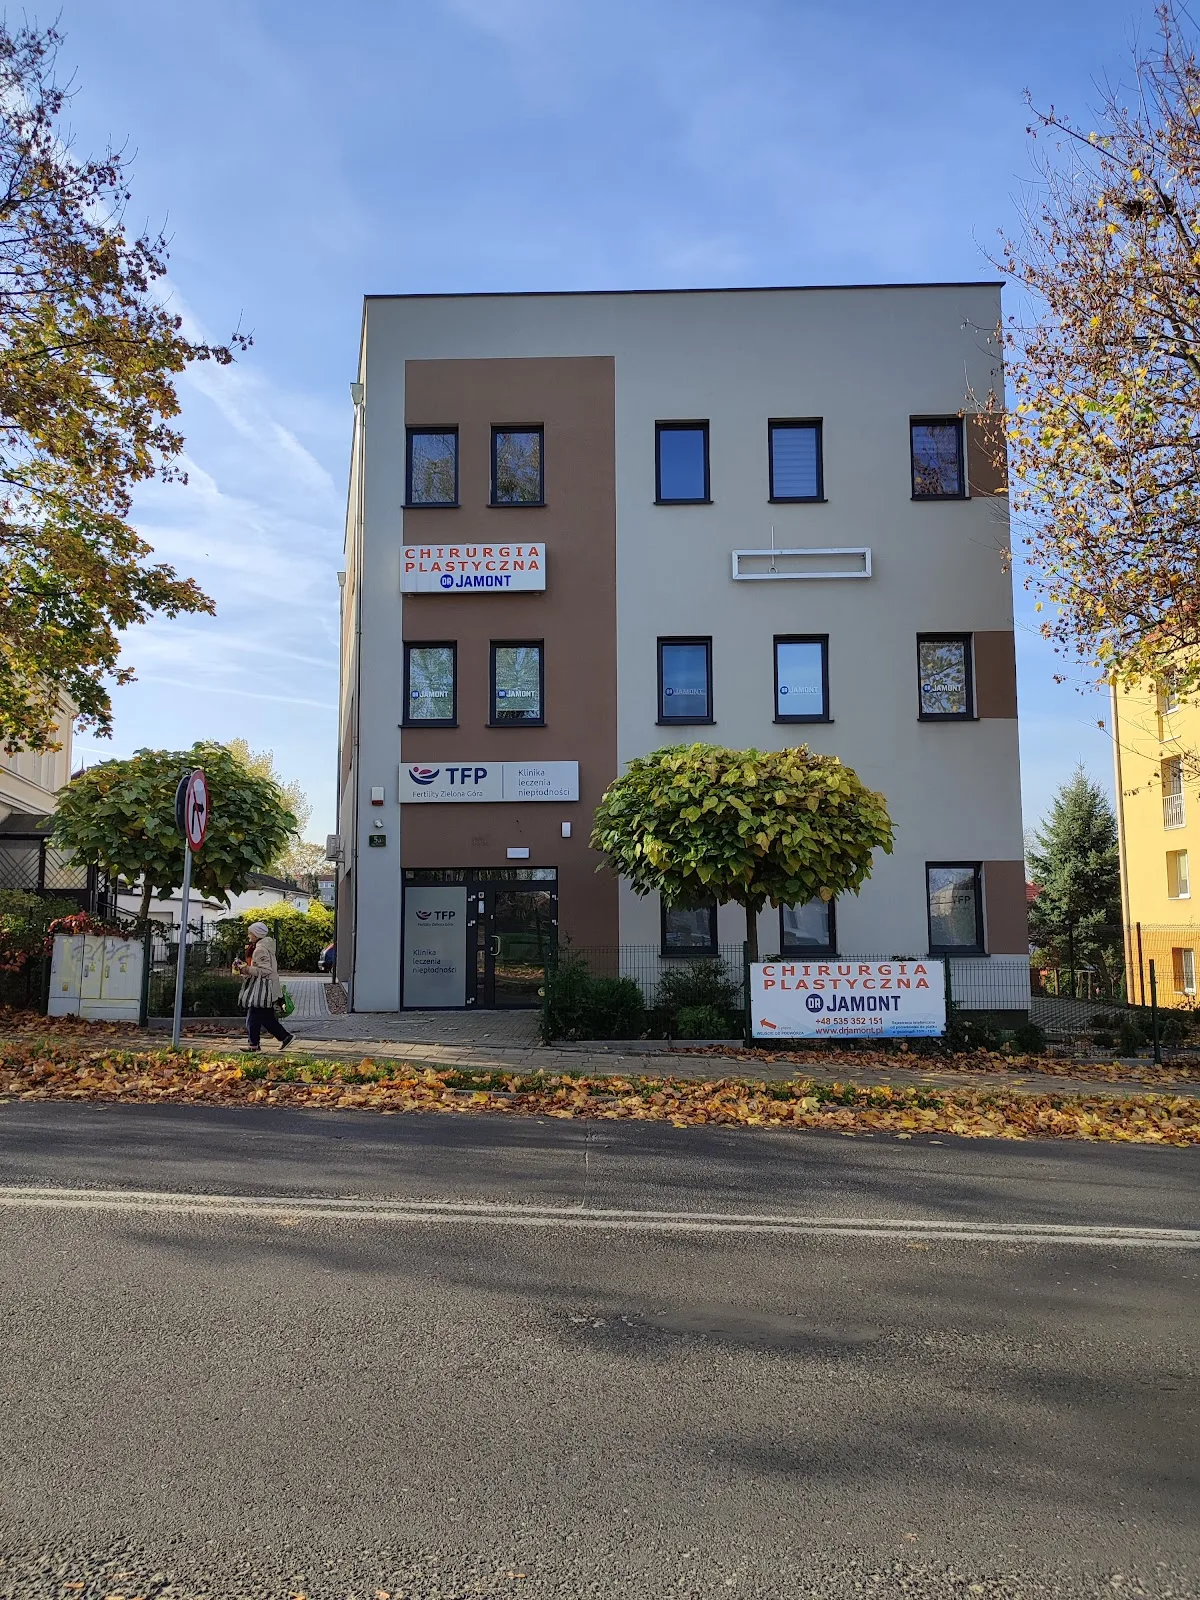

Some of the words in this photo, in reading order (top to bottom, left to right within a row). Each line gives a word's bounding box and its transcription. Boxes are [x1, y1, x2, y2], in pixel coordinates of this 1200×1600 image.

[404, 546, 540, 559] CHIRURGIA
[405, 560, 540, 573] PLASTYCZNA
[456, 574, 511, 588] JAMONT
[788, 686, 818, 694] JAMONT
[932, 684, 962, 692] JAMONT
[419, 690, 449, 698] JAMONT
[445, 767, 488, 785] TFP
[518, 768, 545, 777] Klinika
[518, 778, 551, 787] leczenia
[412, 791, 440, 799] Fertility
[440, 790, 465, 798] Zielona
[467, 789, 483, 797] Góra
[518, 787, 570, 797] niepłodności
[434, 910, 456, 920] TFP
[412, 957, 441, 965] leczenia
[412, 966, 457, 974] niepłodności
[762, 963, 928, 977] CHIRURGIA
[763, 977, 930, 990] PLASTYCZNA
[807, 995, 823, 1011] DR
[826, 994, 901, 1012] JAMONT
[815, 1017, 831, 1025] +48
[833, 1017, 848, 1025] 535
[850, 1017, 866, 1025] 352
[868, 1017, 883, 1025] 151
[815, 1026, 884, 1036] www.drjamont.pl
